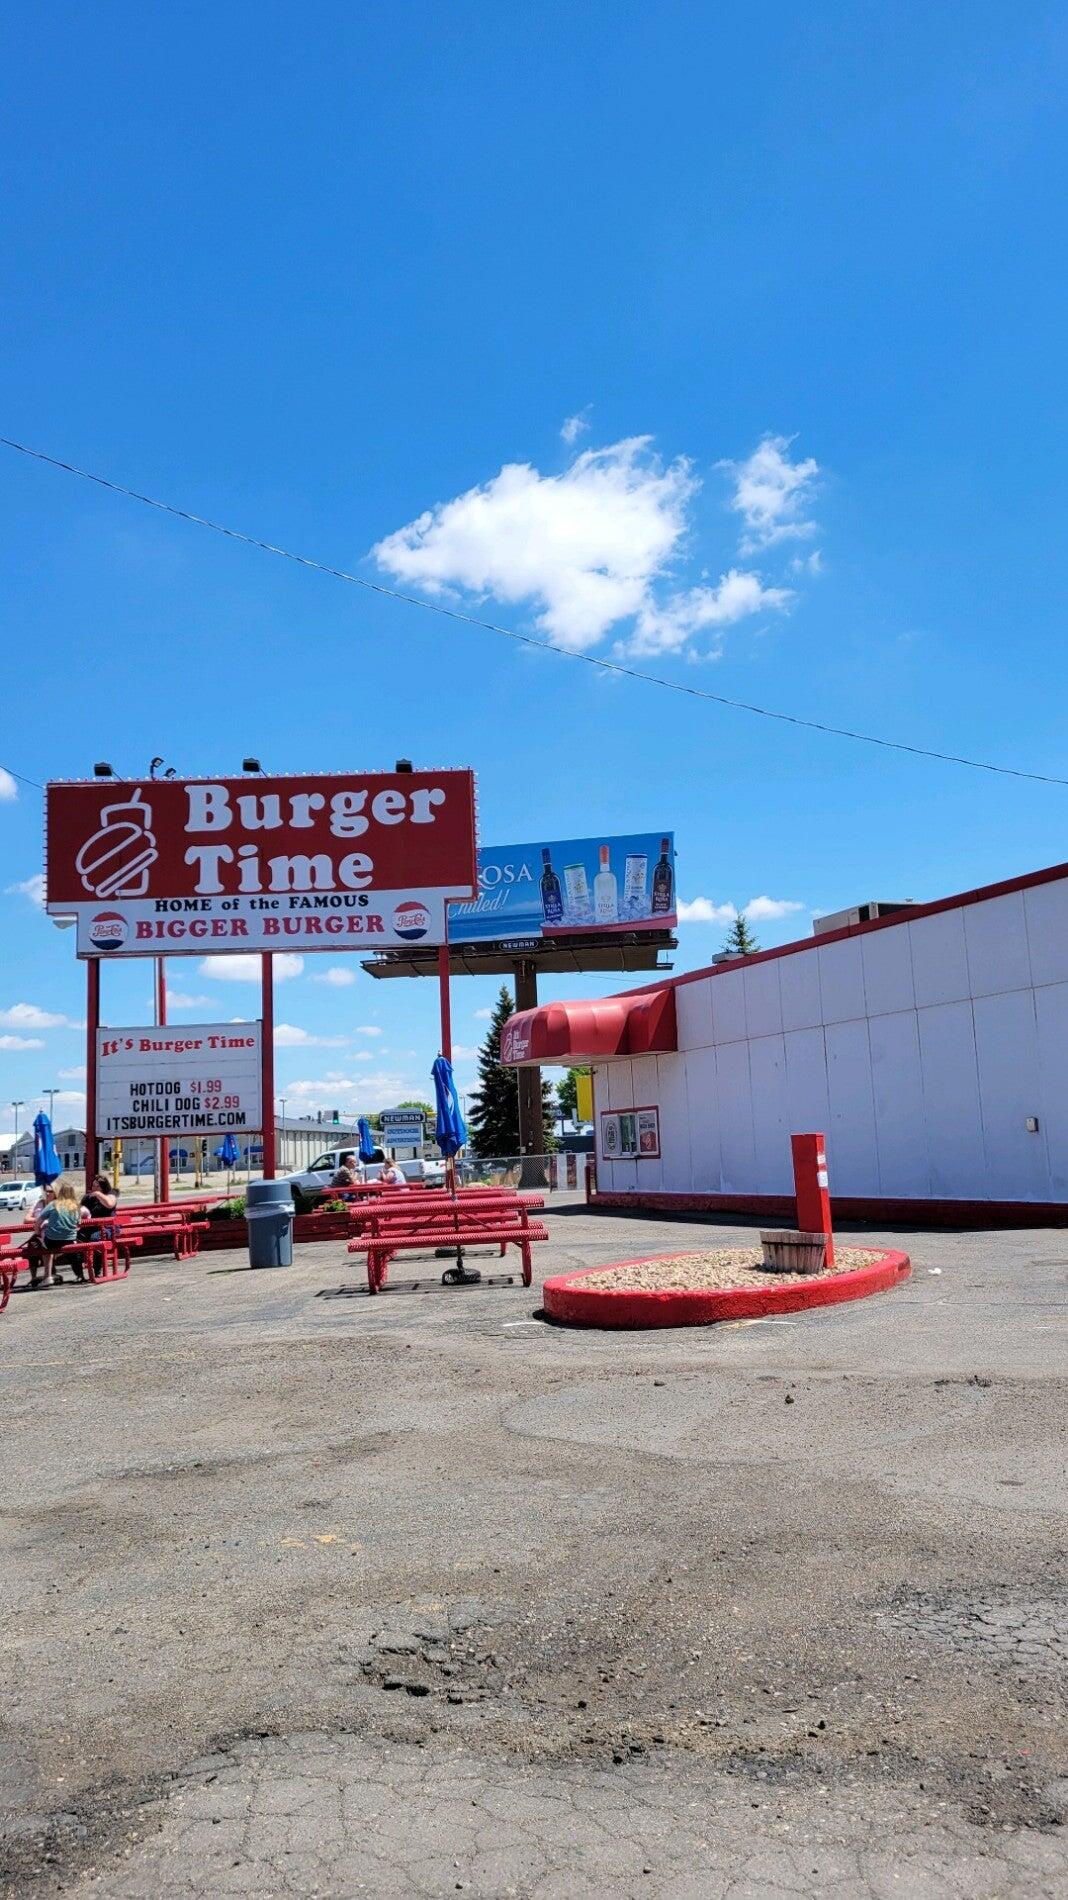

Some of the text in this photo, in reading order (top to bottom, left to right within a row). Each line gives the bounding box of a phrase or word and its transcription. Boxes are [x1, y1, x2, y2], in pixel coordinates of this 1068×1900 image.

[184, 785, 446, 838] Burger
[184, 844, 374, 894] Time
[477, 863, 533, 890] OSA
[155, 895, 369, 912] HOME of the FAMOUS
[136, 915, 385, 939] BIGGER BURGER
[503, 941, 535, 949] NEWMAN
[101, 1035, 255, 1057] It's Burger Time
[130, 1079, 222, 1096] HOTDOG $1.99
[133, 1095, 240, 1113] CHILI DOG $2.99
[107, 1112, 246, 1130] ITSBURGERTIME.COM
[384, 1114, 421, 1122] NEWMAN
